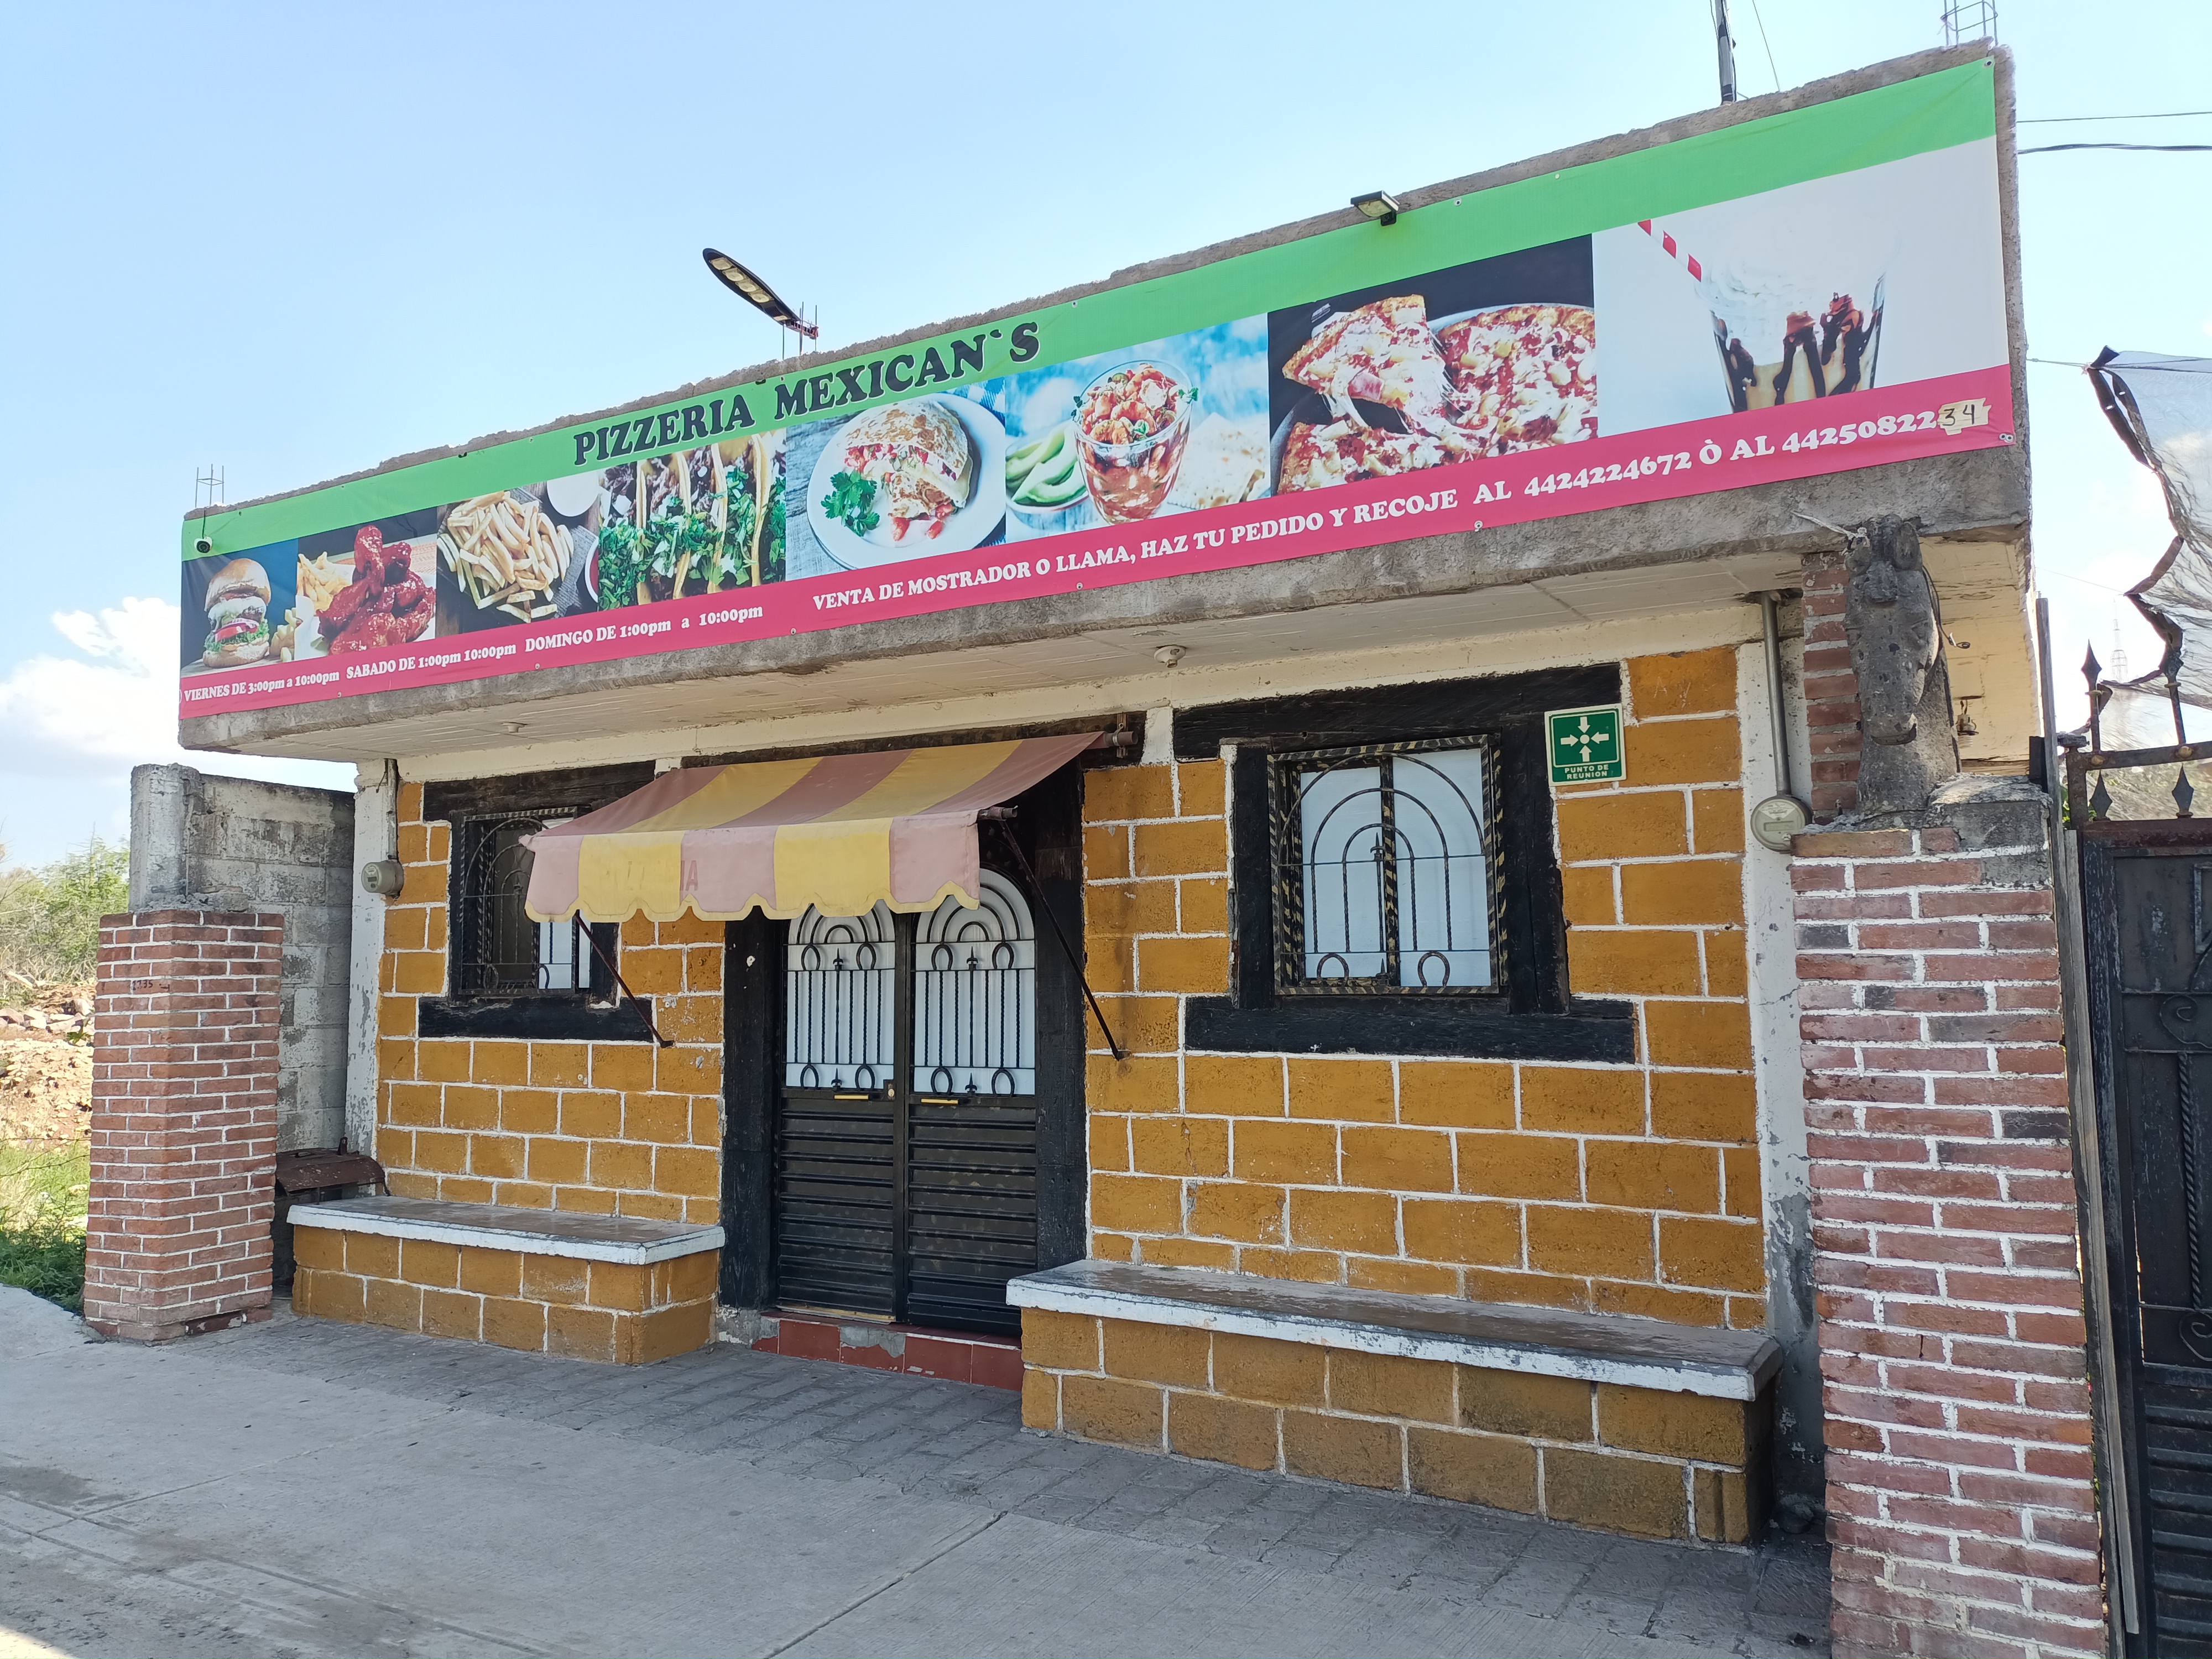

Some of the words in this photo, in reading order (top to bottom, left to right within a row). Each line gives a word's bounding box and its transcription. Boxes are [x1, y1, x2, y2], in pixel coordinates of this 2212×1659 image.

[573, 394, 756, 467] PIZZERIA
[813, 587, 875, 610] VENTA
[879, 582, 904, 600] DE
[907, 560, 1031, 596] MOSTRADOR
[1036, 559, 1051, 575] O
[1056, 546, 1136, 572] LLAMA,
[1141, 535, 1188, 559] HAZ
[1193, 528, 1225, 550] TU
[1230, 512, 1324, 544] PEDIDO
[1329, 507, 1348, 527] Y
[1353, 489, 1458, 524] RECOJE
[1473, 481, 1512, 504] AL
[1524, 451, 1692, 497] 4424224672
[1699, 439, 1722, 465] Ò
[1730, 435, 1775, 461] AL
[184, 684, 231, 702] VIERNES
[231, 682, 247, 695] DE
[247, 680, 285, 695] 3:00pm
[286, 678, 293, 687] a
[295, 671, 340, 686] 10:00pm
[346, 660, 397, 679] SABADO
[398, 656, 416, 671] DE
[418, 653, 461, 668] 1:00pm
[464, 644, 517, 661] 10:00pm
[525, 628, 593, 652] DOMINGO
[596, 625, 617, 641] DE
[620, 620, 671, 638] 1:00pm
[681, 618, 690, 629] a
[699, 606, 763, 626] 10:00pm
